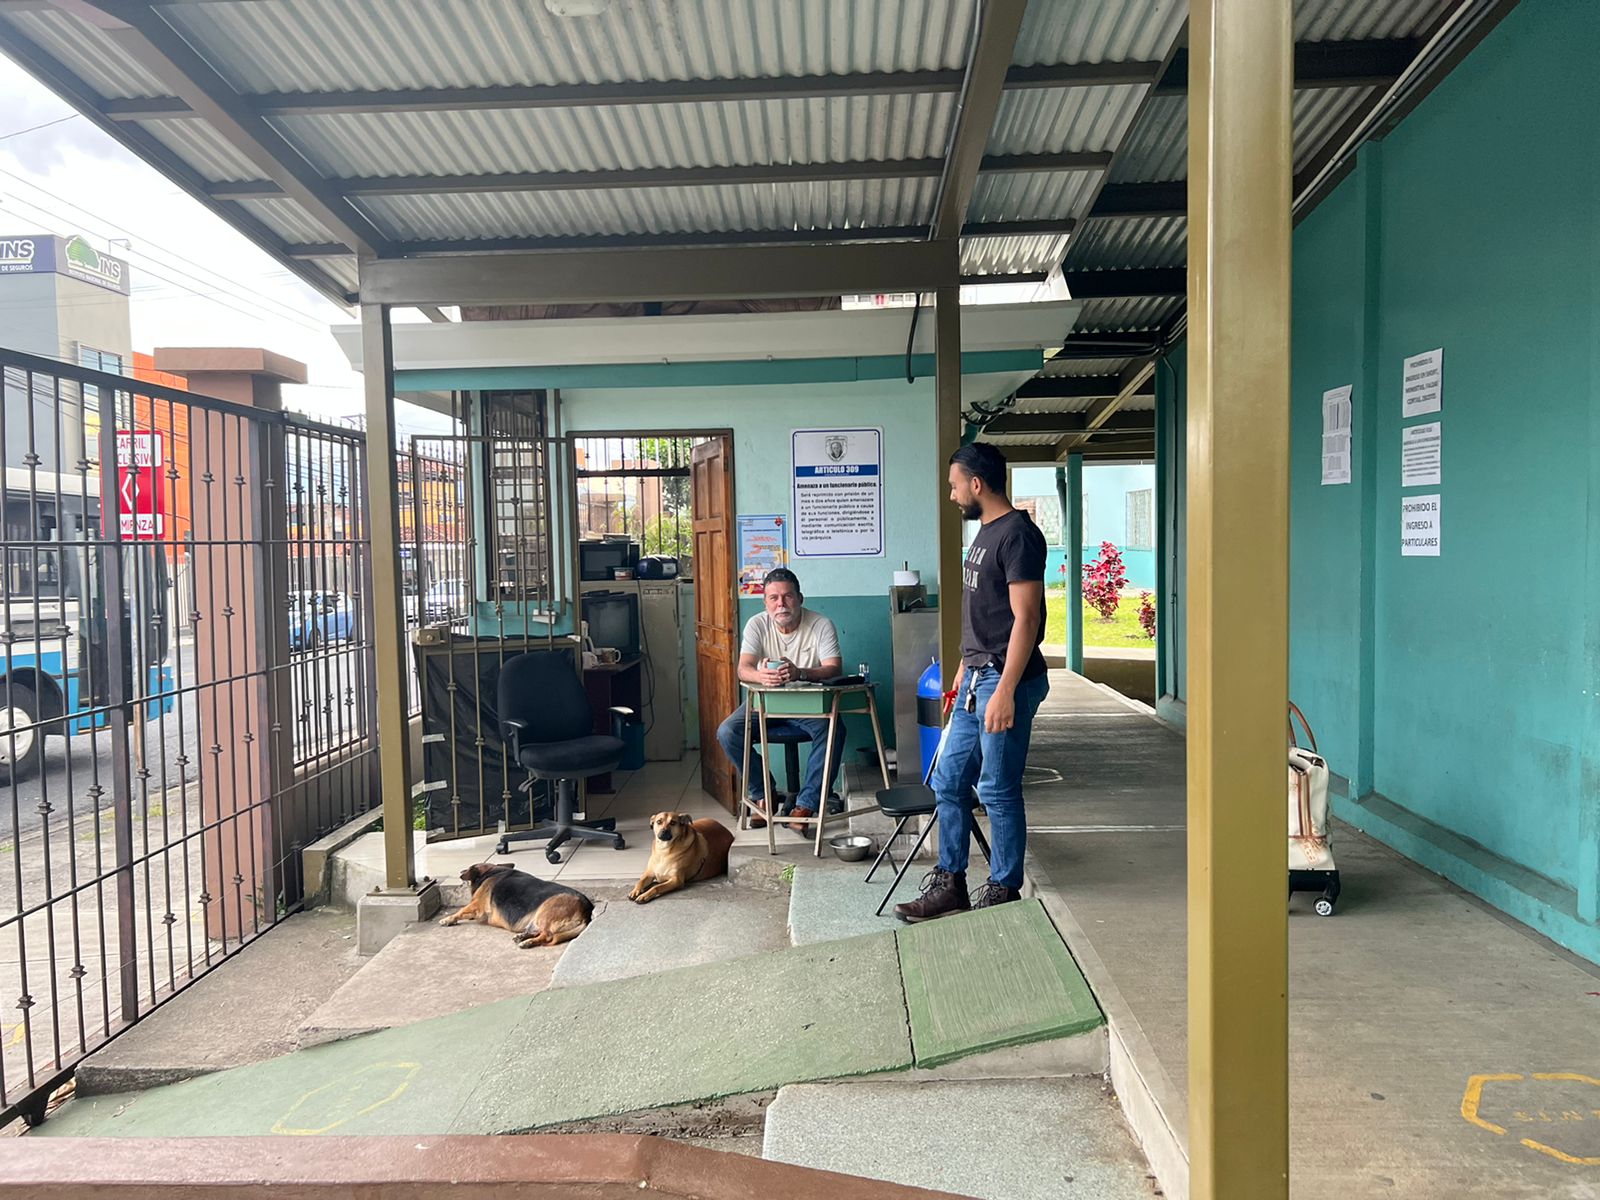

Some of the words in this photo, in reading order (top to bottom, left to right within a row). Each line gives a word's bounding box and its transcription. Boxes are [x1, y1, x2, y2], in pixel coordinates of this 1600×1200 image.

[100, 258, 120, 278] INS
[1402, 503, 1430, 512] PROHIBIDO
[1432, 502, 1437, 511] EL
[1406, 521, 1428, 530] INGRESO
[1401, 538, 1437, 546] PARTICULARES
